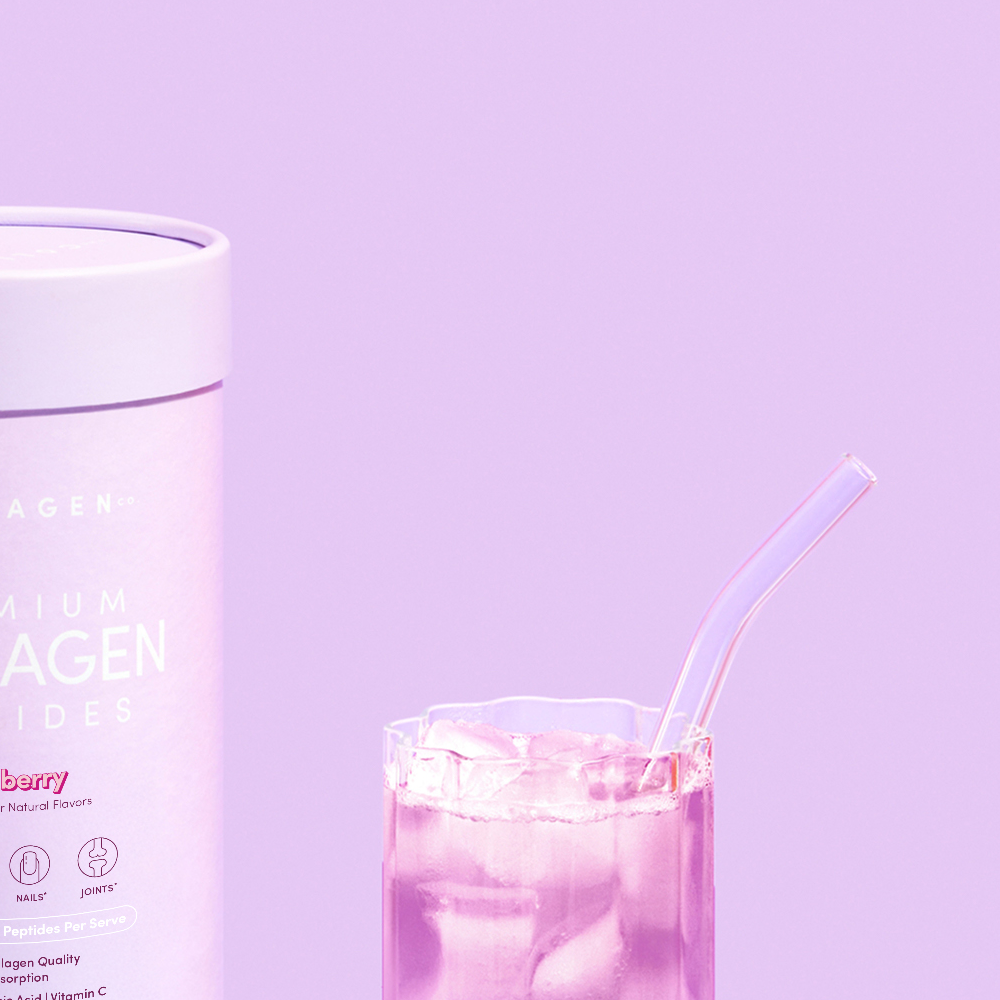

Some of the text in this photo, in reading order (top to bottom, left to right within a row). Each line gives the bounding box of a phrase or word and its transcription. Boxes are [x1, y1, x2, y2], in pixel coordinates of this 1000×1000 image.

[0, 768, 70, 795] berry
[8, 800, 49, 813] Natural
[52, 797, 93, 811] Flavors
[3, 923, 62, 941] Peptides
[64, 921, 87, 933] Per
[88, 914, 128, 929] Serve
[37, 954, 81, 968] Quality
[97, 986, 107, 997] C
